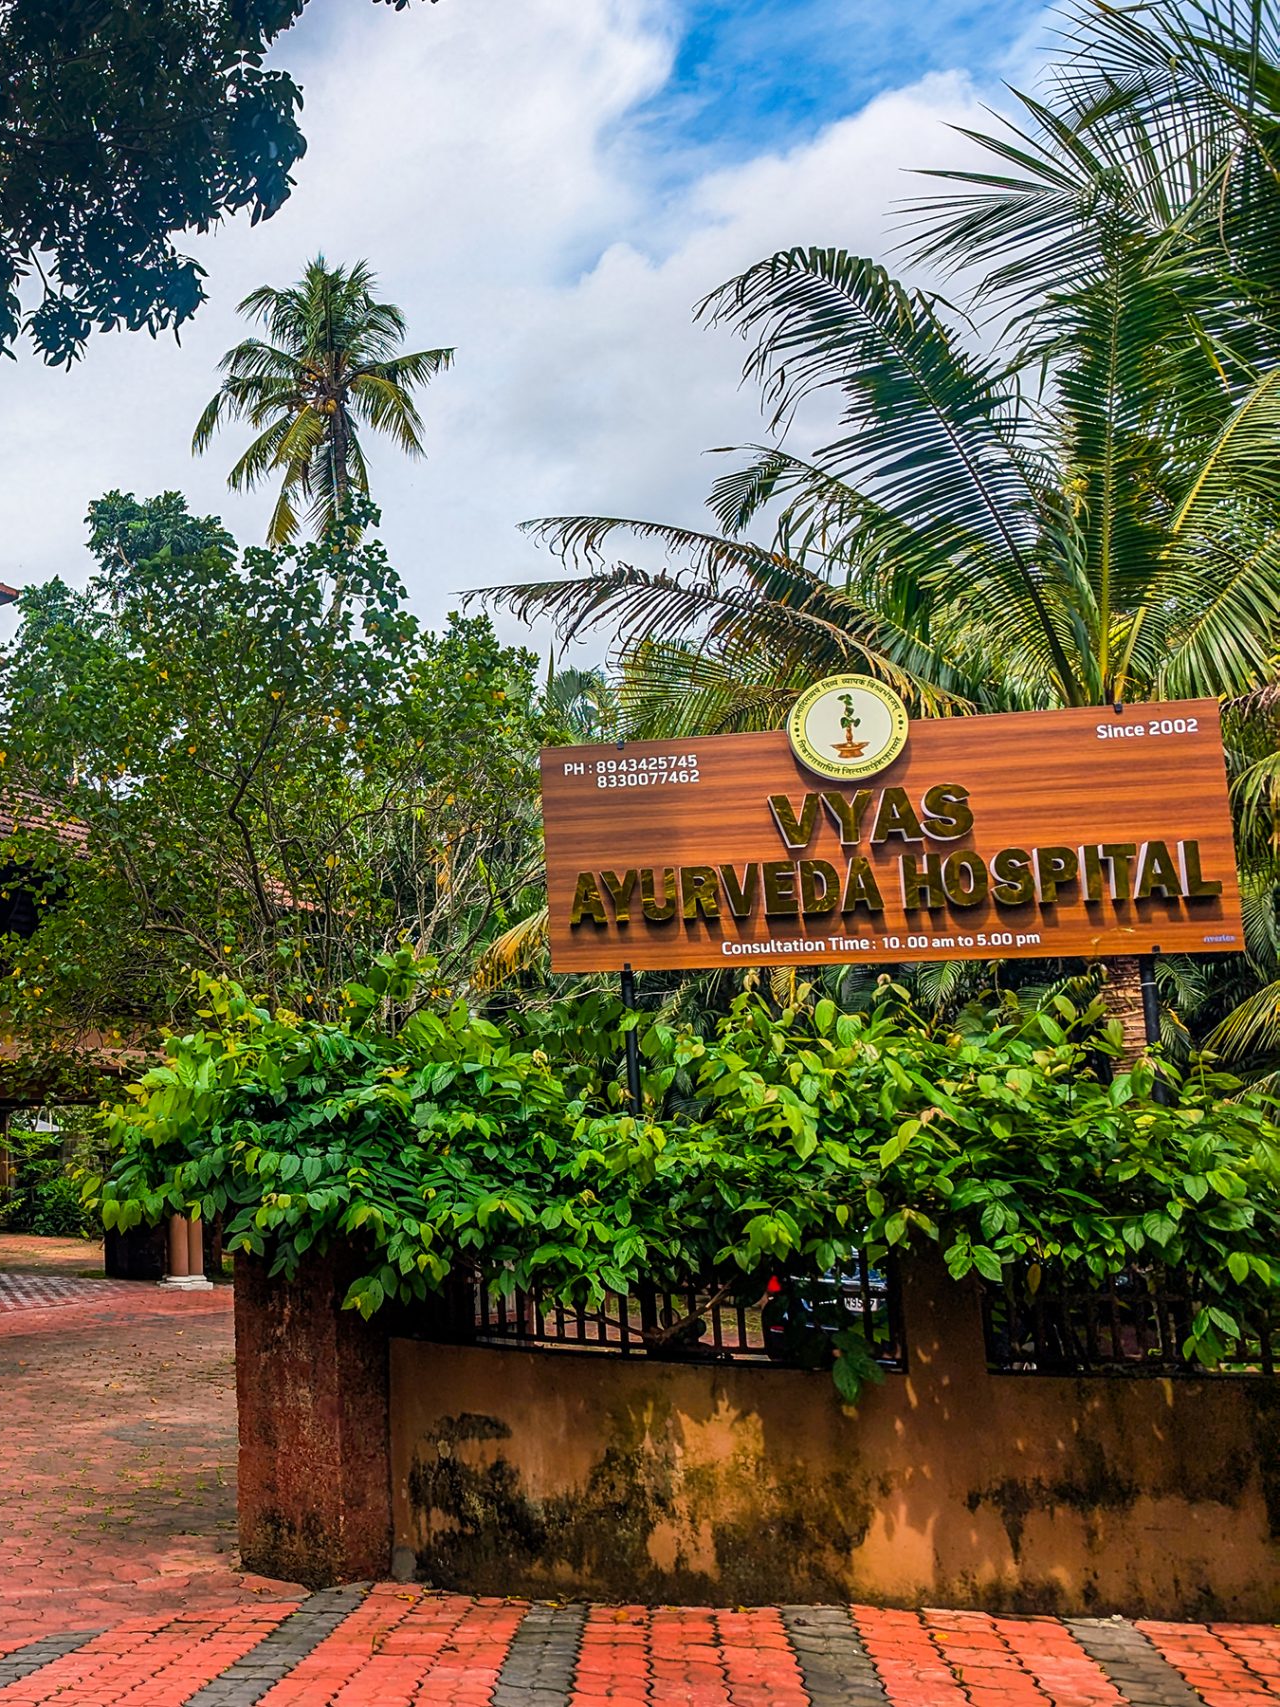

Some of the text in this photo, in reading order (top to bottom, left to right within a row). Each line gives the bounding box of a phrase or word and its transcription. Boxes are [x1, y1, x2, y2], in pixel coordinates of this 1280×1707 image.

[1096, 718, 1199, 739] Since 2002
[596, 754, 698, 774] 8943425745
[597, 769, 700, 788] 8330077462
[767, 783, 975, 848] VYAS
[570, 839, 1223, 924] AYURVEDA HOSPITAL
[721, 939, 825, 955] Consultation
[882, 936, 928, 949] 10.00
[932, 937, 955, 948] am
[957, 935, 974, 947] to
[976, 932, 1014, 946] 5.00
[1016, 933, 1041, 947] pm
